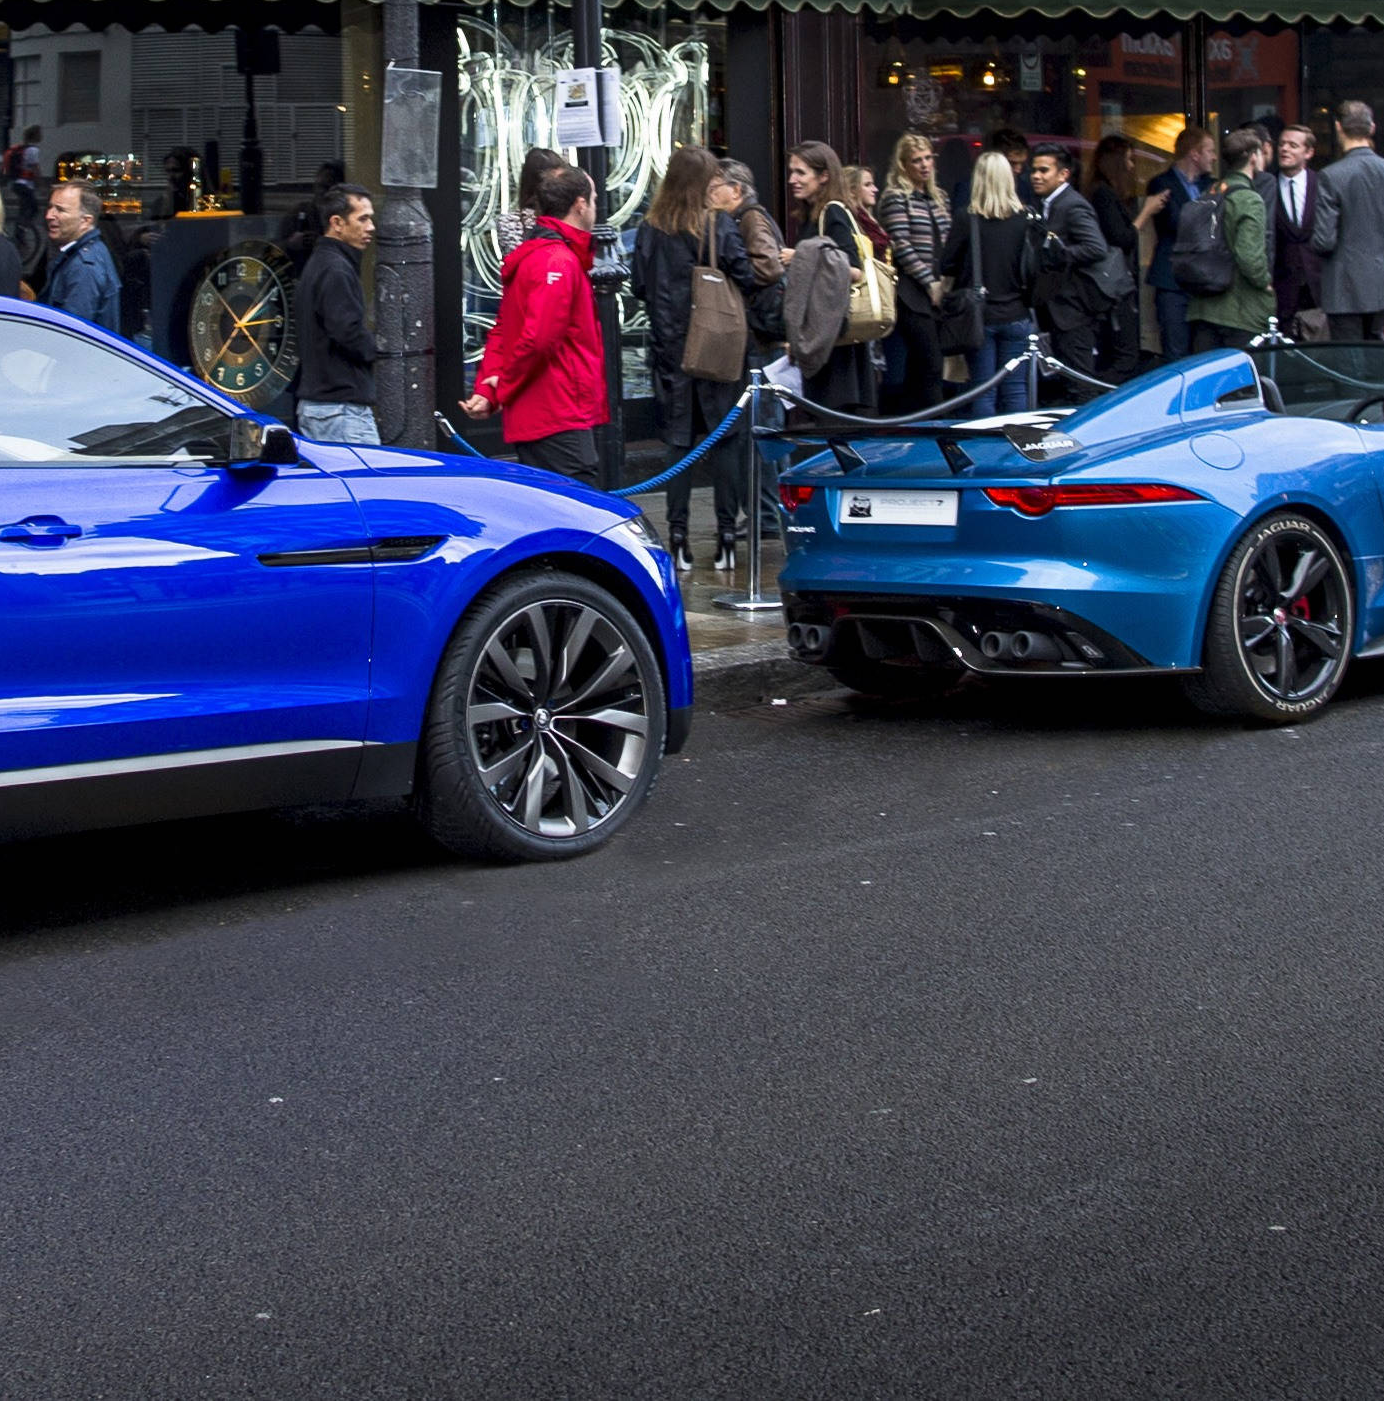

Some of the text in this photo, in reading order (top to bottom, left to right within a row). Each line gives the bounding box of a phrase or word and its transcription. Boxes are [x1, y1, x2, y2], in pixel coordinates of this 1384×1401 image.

[254, 363, 264, 377] 5
[236, 373, 246, 386] 6
[1256, 520, 1311, 547] JAGUAR
